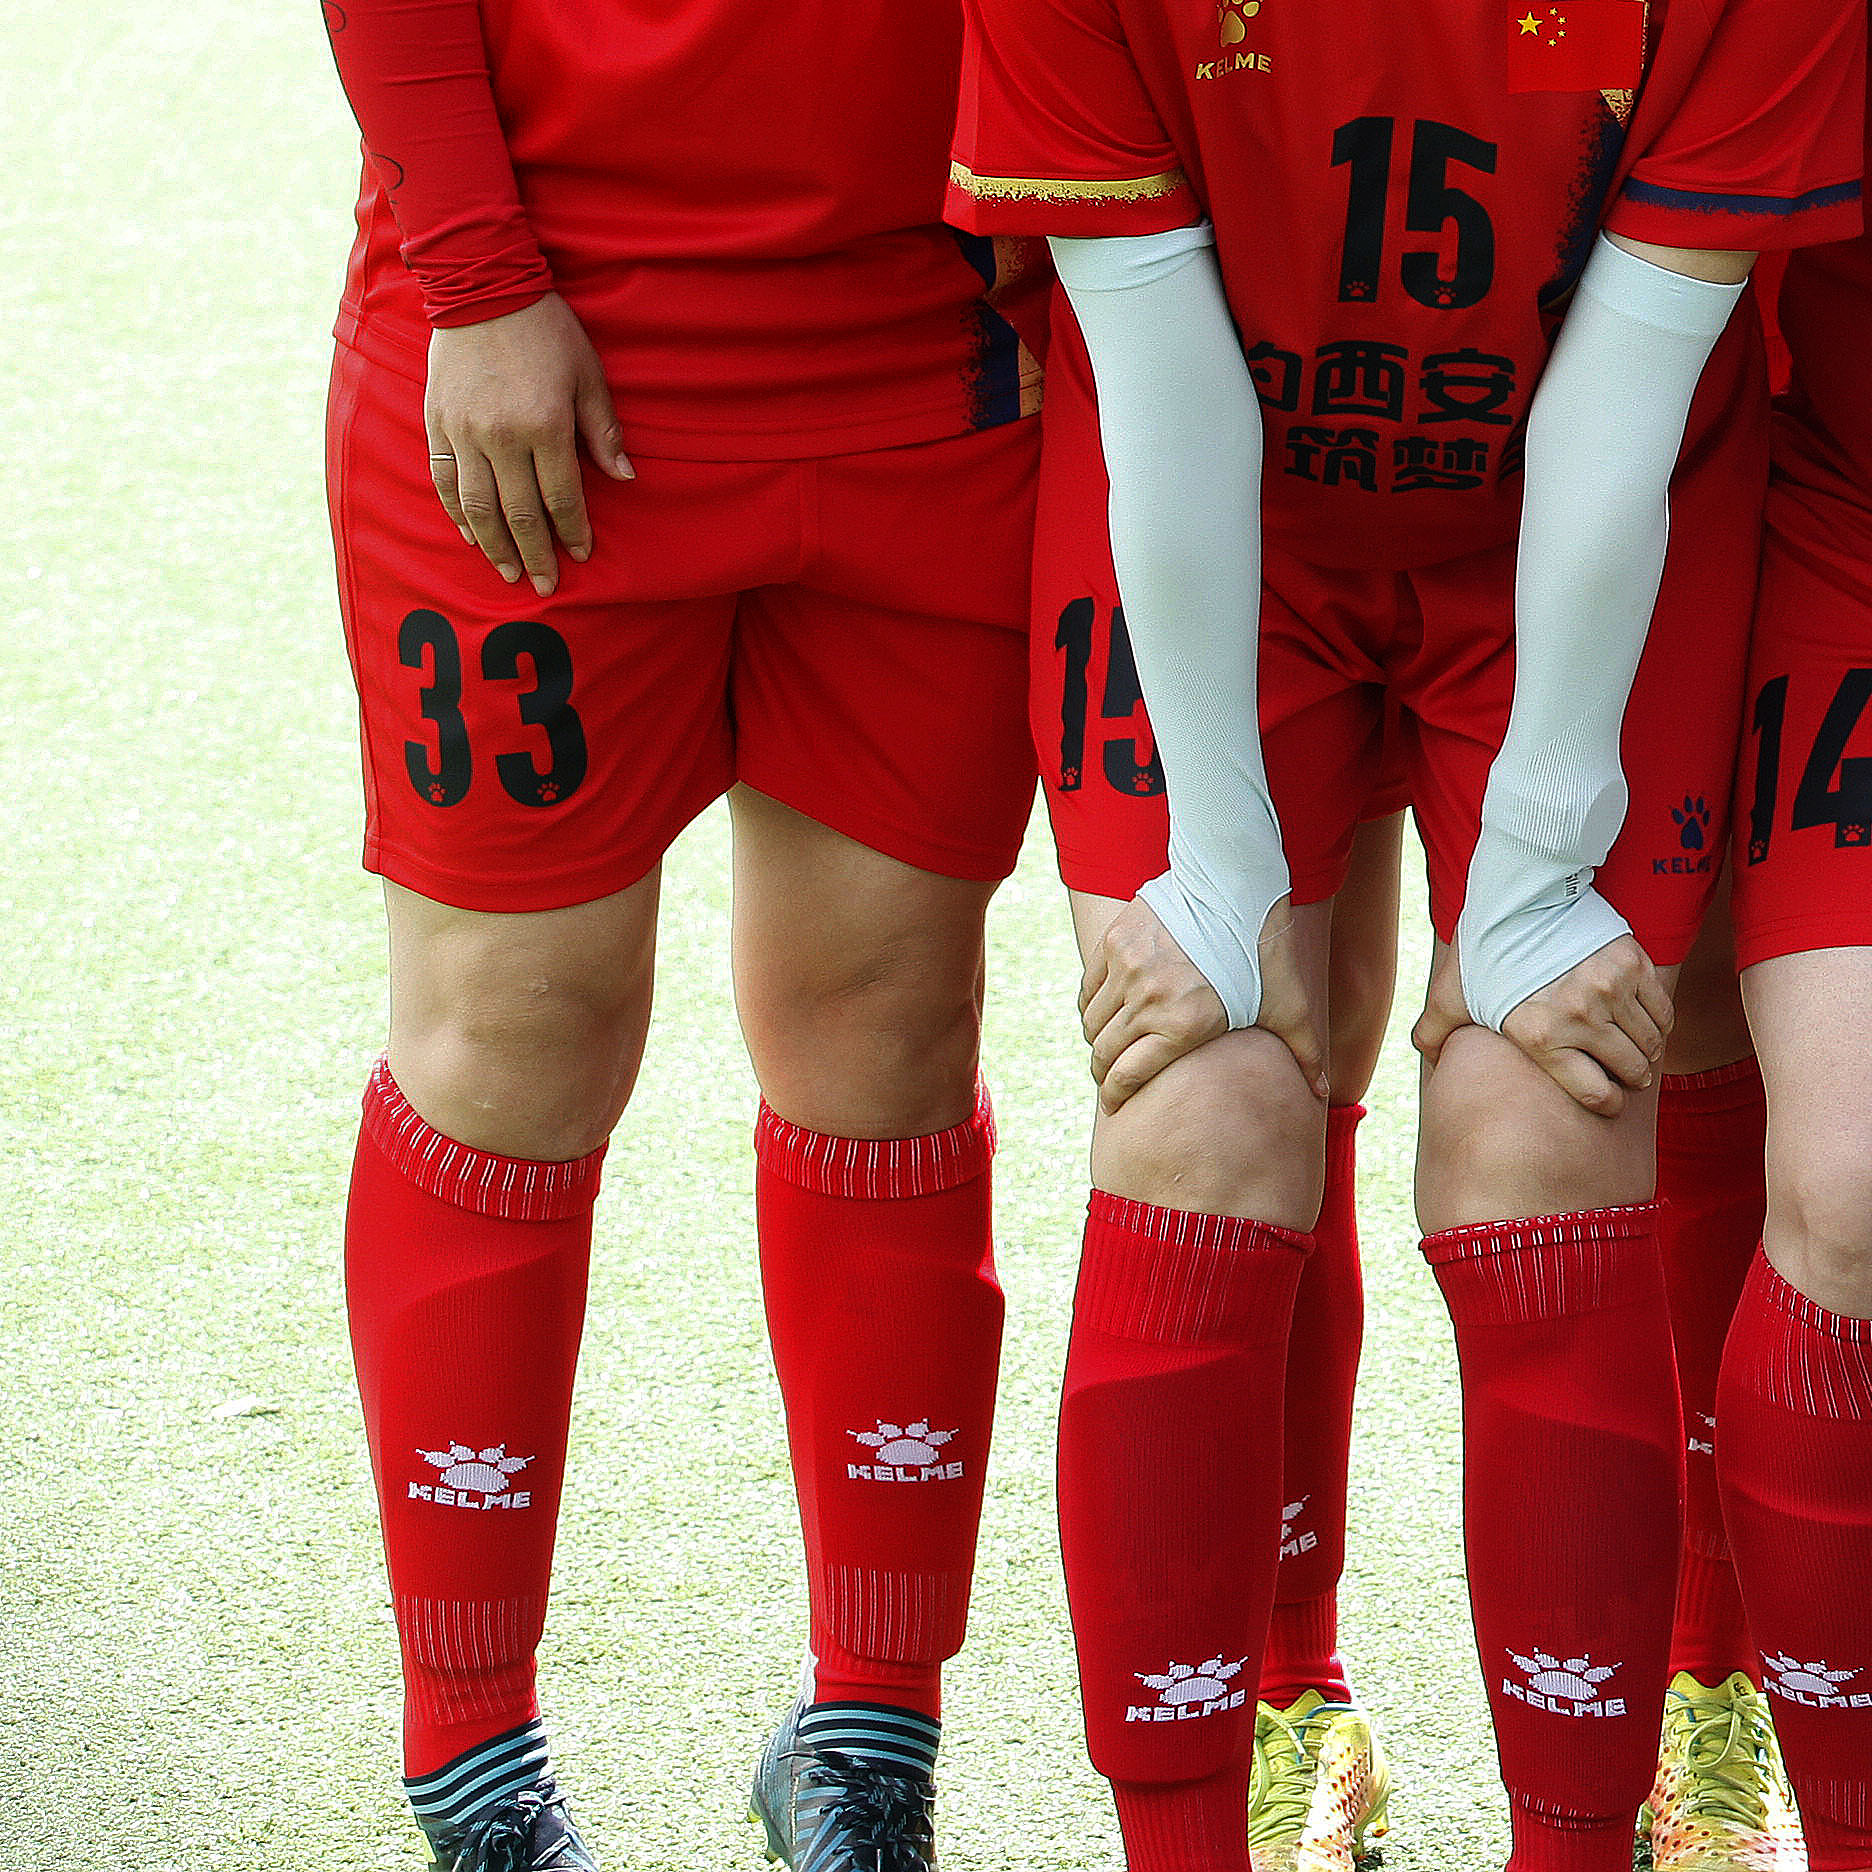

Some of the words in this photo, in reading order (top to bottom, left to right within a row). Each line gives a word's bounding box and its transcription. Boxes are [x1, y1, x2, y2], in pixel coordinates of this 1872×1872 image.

[1195, 49, 1273, 82] KELME
[1330, 116, 1498, 310] 15
[399, 608, 590, 808] 33
[847, 1460, 964, 1481] KELME
[409, 1482, 531, 1511] KELME
[1125, 1692, 1245, 1723] KELME
[1502, 1679, 1626, 1718] KELME
